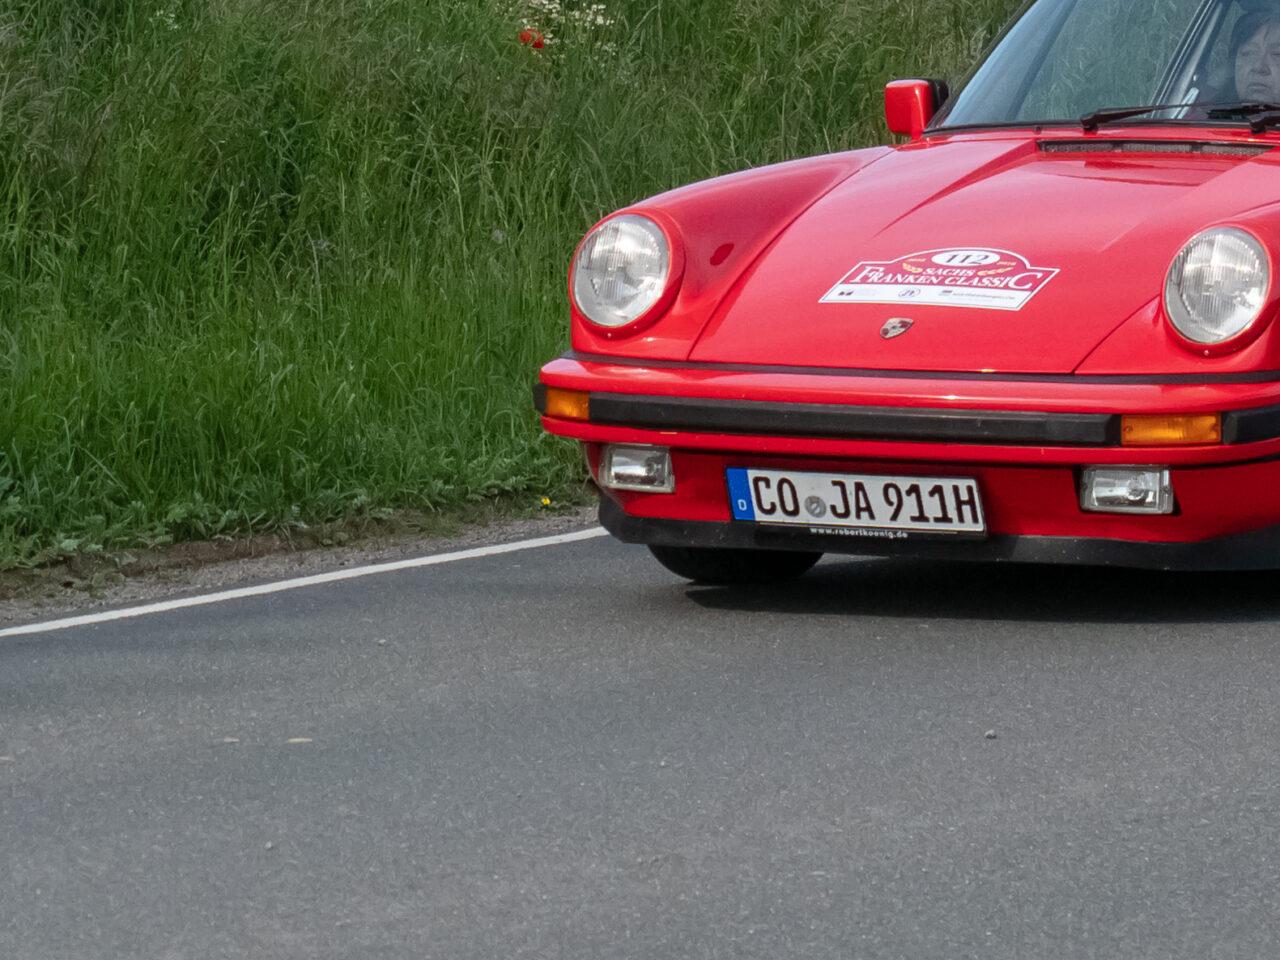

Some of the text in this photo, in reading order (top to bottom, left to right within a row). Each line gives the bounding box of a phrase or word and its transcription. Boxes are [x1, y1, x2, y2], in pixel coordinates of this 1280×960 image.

[946, 254, 989, 265] 112
[850, 266, 1042, 289] FRANKEN CLASSIC
[922, 267, 976, 277] SACHS
[752, 476, 979, 524] CO JA 911H
